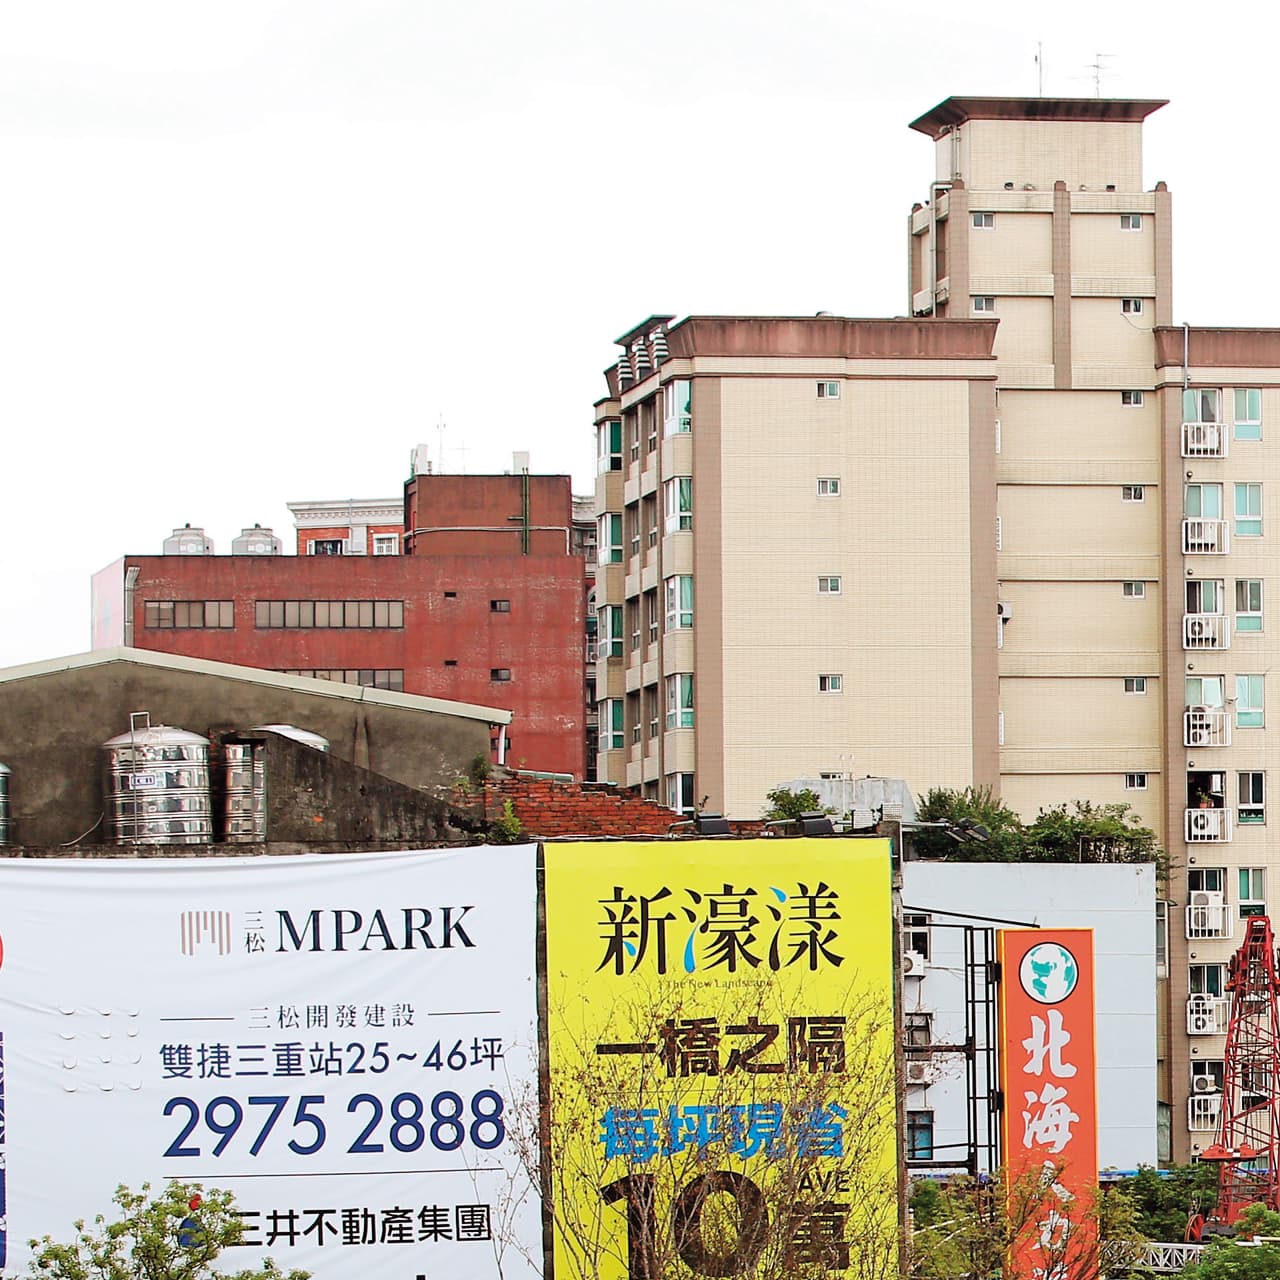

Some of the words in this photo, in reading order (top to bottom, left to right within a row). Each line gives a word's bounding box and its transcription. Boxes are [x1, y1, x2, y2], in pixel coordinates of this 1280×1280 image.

[243, 910, 266, 954] 三松
[274, 905, 478, 953] MPARK
[594, 881, 846, 976] 新濠漾
[247, 1003, 416, 1029] 三松開發建設
[595, 1016, 847, 1078] 一橋之隔
[161, 1095, 327, 1158] 2975
[346, 1088, 505, 1154] 2888
[229, 1204, 494, 1248] 三井不動產集團
[600, 1170, 771, 1280] 10
